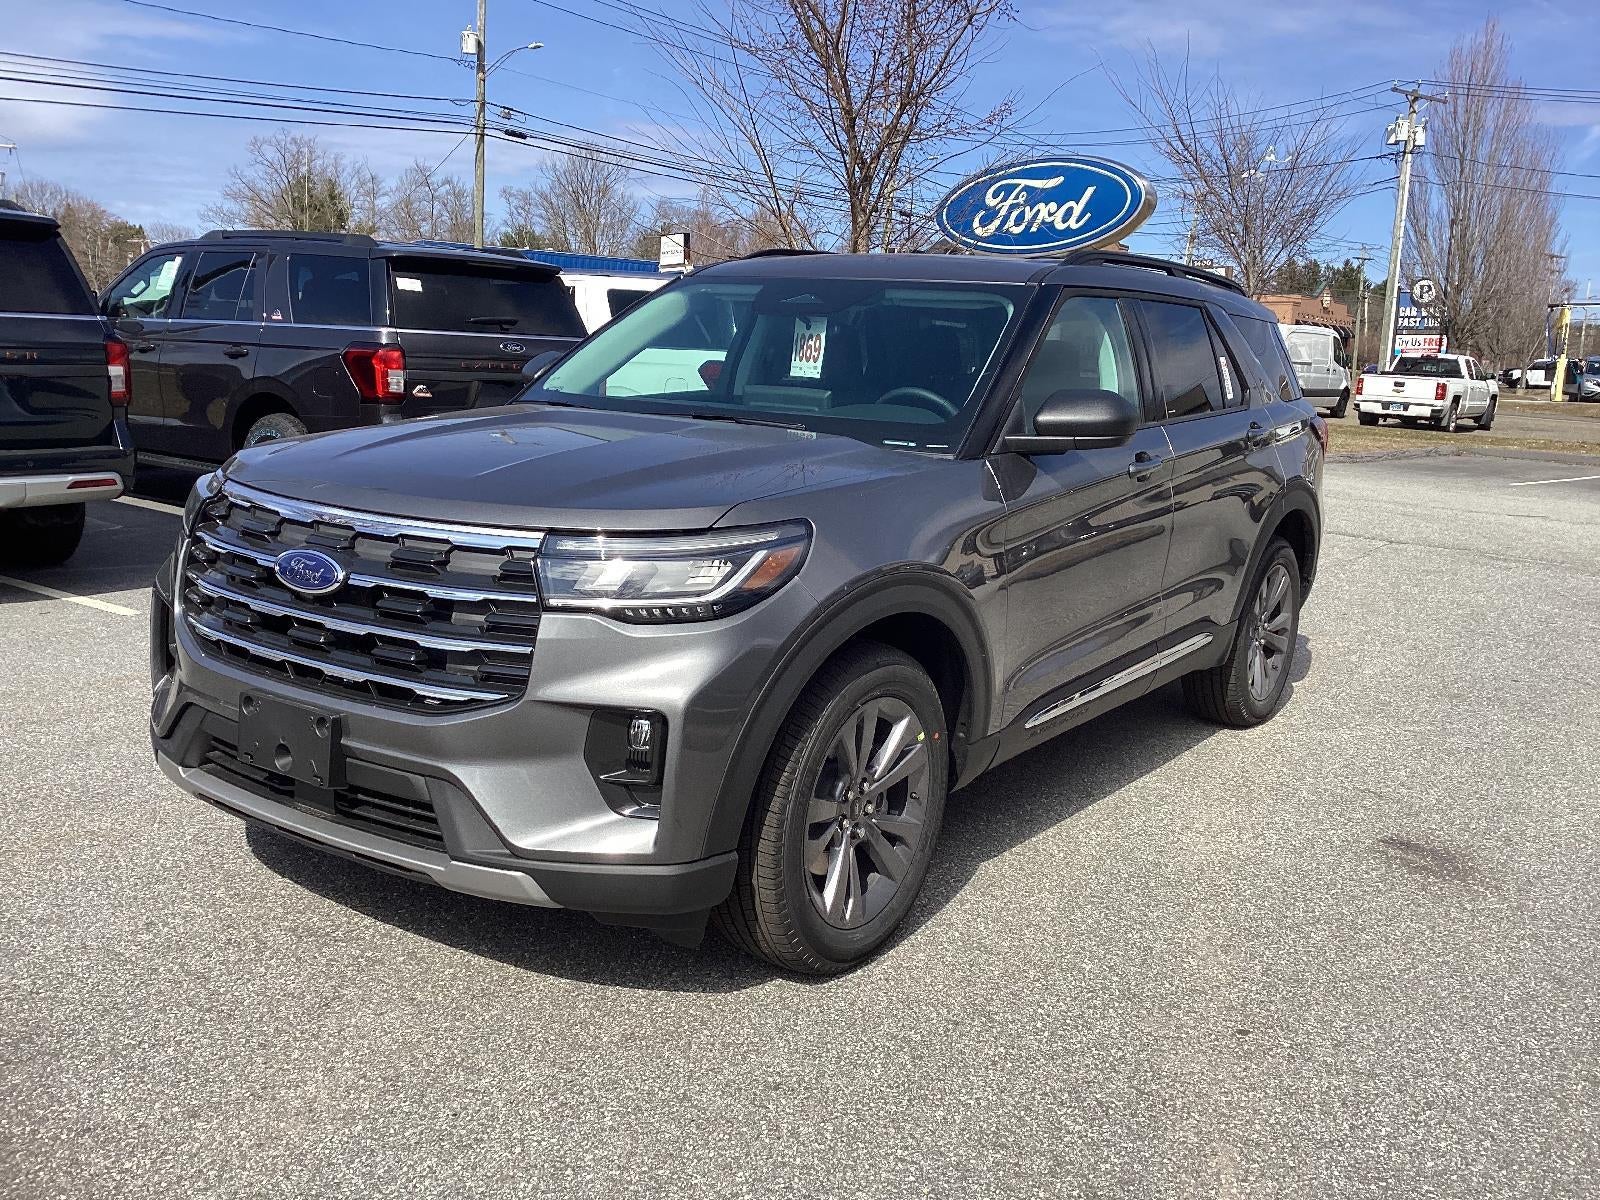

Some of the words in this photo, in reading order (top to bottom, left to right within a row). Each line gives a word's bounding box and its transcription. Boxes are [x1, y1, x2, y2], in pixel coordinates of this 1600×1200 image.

[972, 176, 1097, 237] Ford
[1399, 306, 1418, 317] CAR
[1397, 317, 1422, 327] FAST
[793, 333, 822, 364] 1869
[1398, 337, 1410, 347] Try
[1411, 337, 1422, 347] Us
[1423, 337, 1446, 347] FREE
[286, 556, 325, 584] Ford
